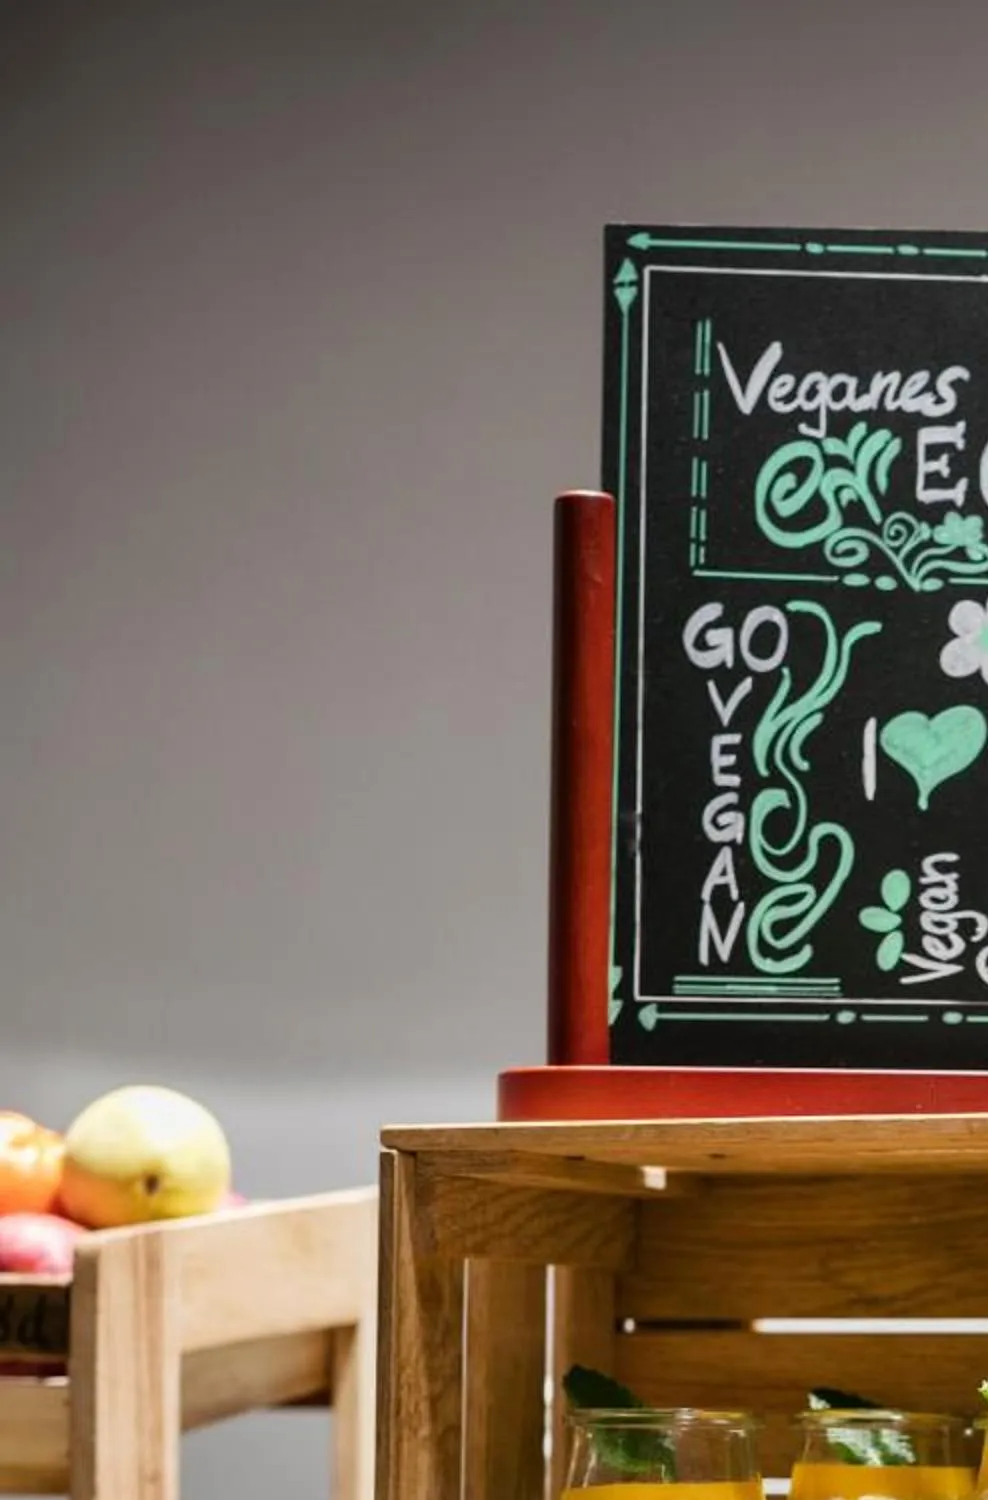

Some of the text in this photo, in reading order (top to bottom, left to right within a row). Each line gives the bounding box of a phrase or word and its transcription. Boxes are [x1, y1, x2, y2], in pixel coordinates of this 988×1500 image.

[716, 340, 971, 438] Veganes
[682, 601, 790, 673] GO
[862, 715, 877, 801] I
[698, 675, 753, 966] VEGAN
